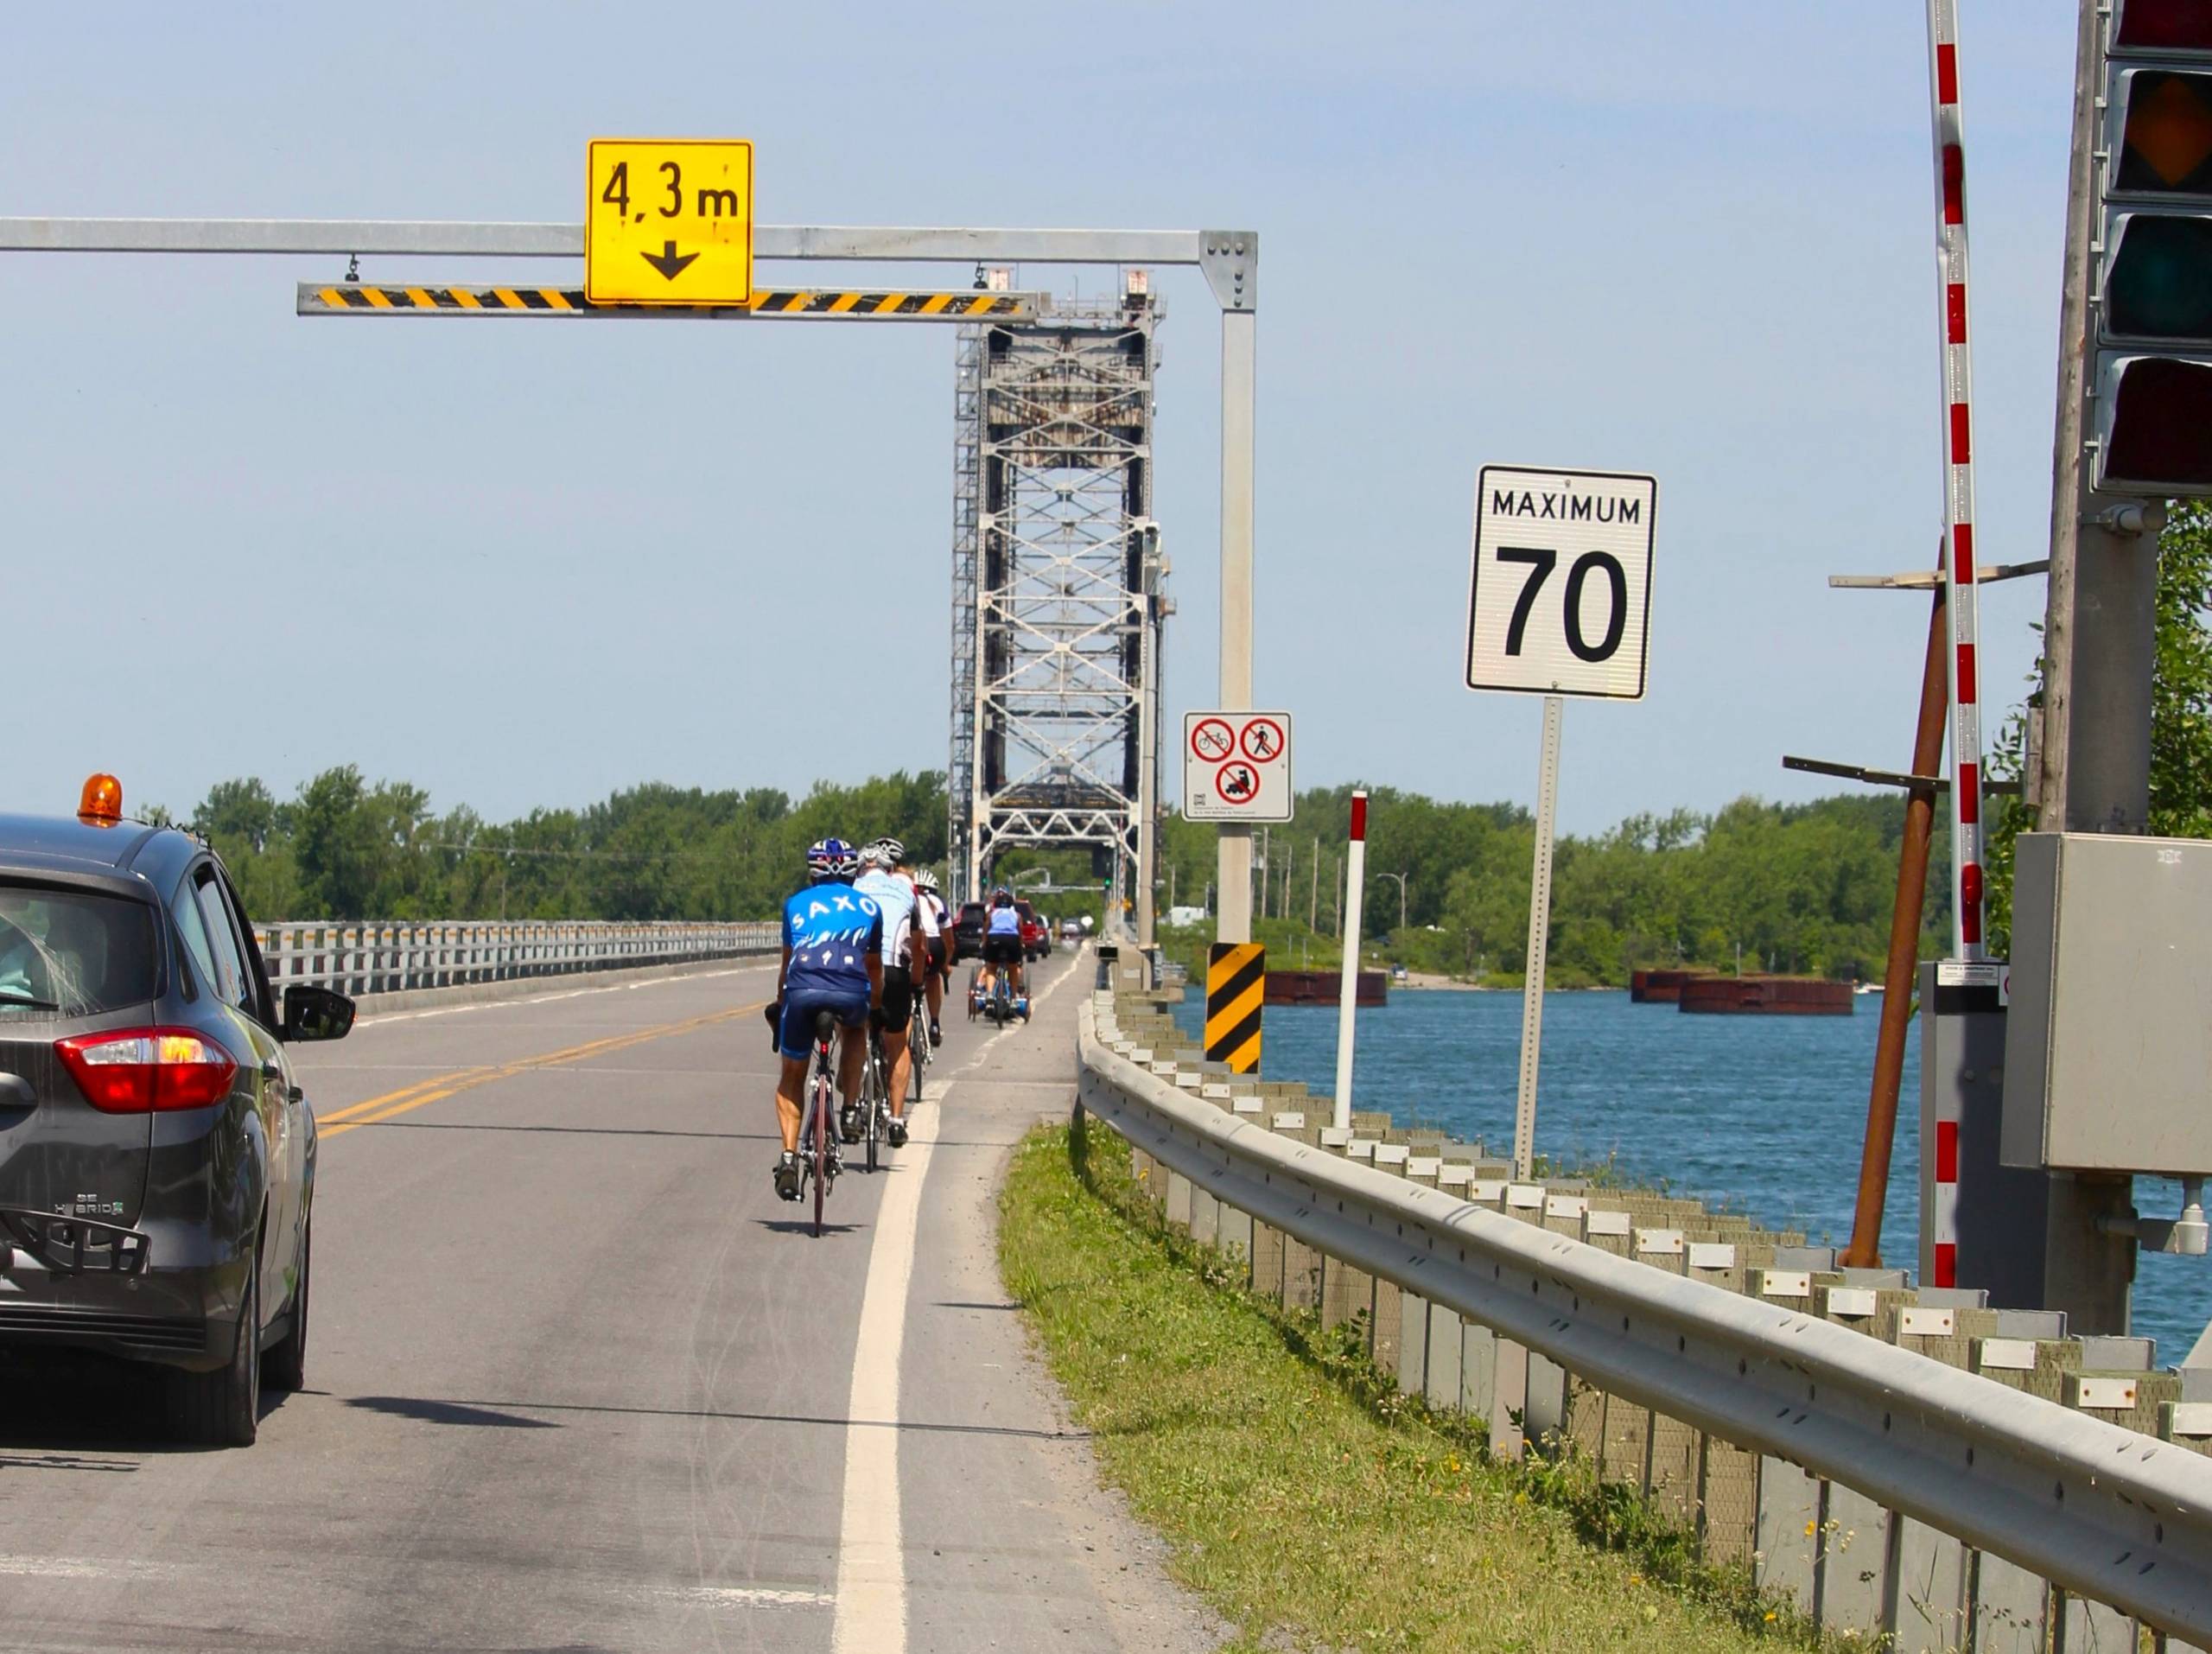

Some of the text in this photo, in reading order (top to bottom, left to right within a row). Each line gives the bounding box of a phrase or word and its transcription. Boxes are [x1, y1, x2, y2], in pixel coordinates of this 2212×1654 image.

[602, 161, 738, 223] 4,3 m
[1492, 489, 1640, 525] MAXIMUM
[1497, 546, 1628, 663] 70
[792, 895, 877, 931] SAXO
[54, 1204, 112, 1214] HBRID
[76, 1193, 98, 1202] SE
